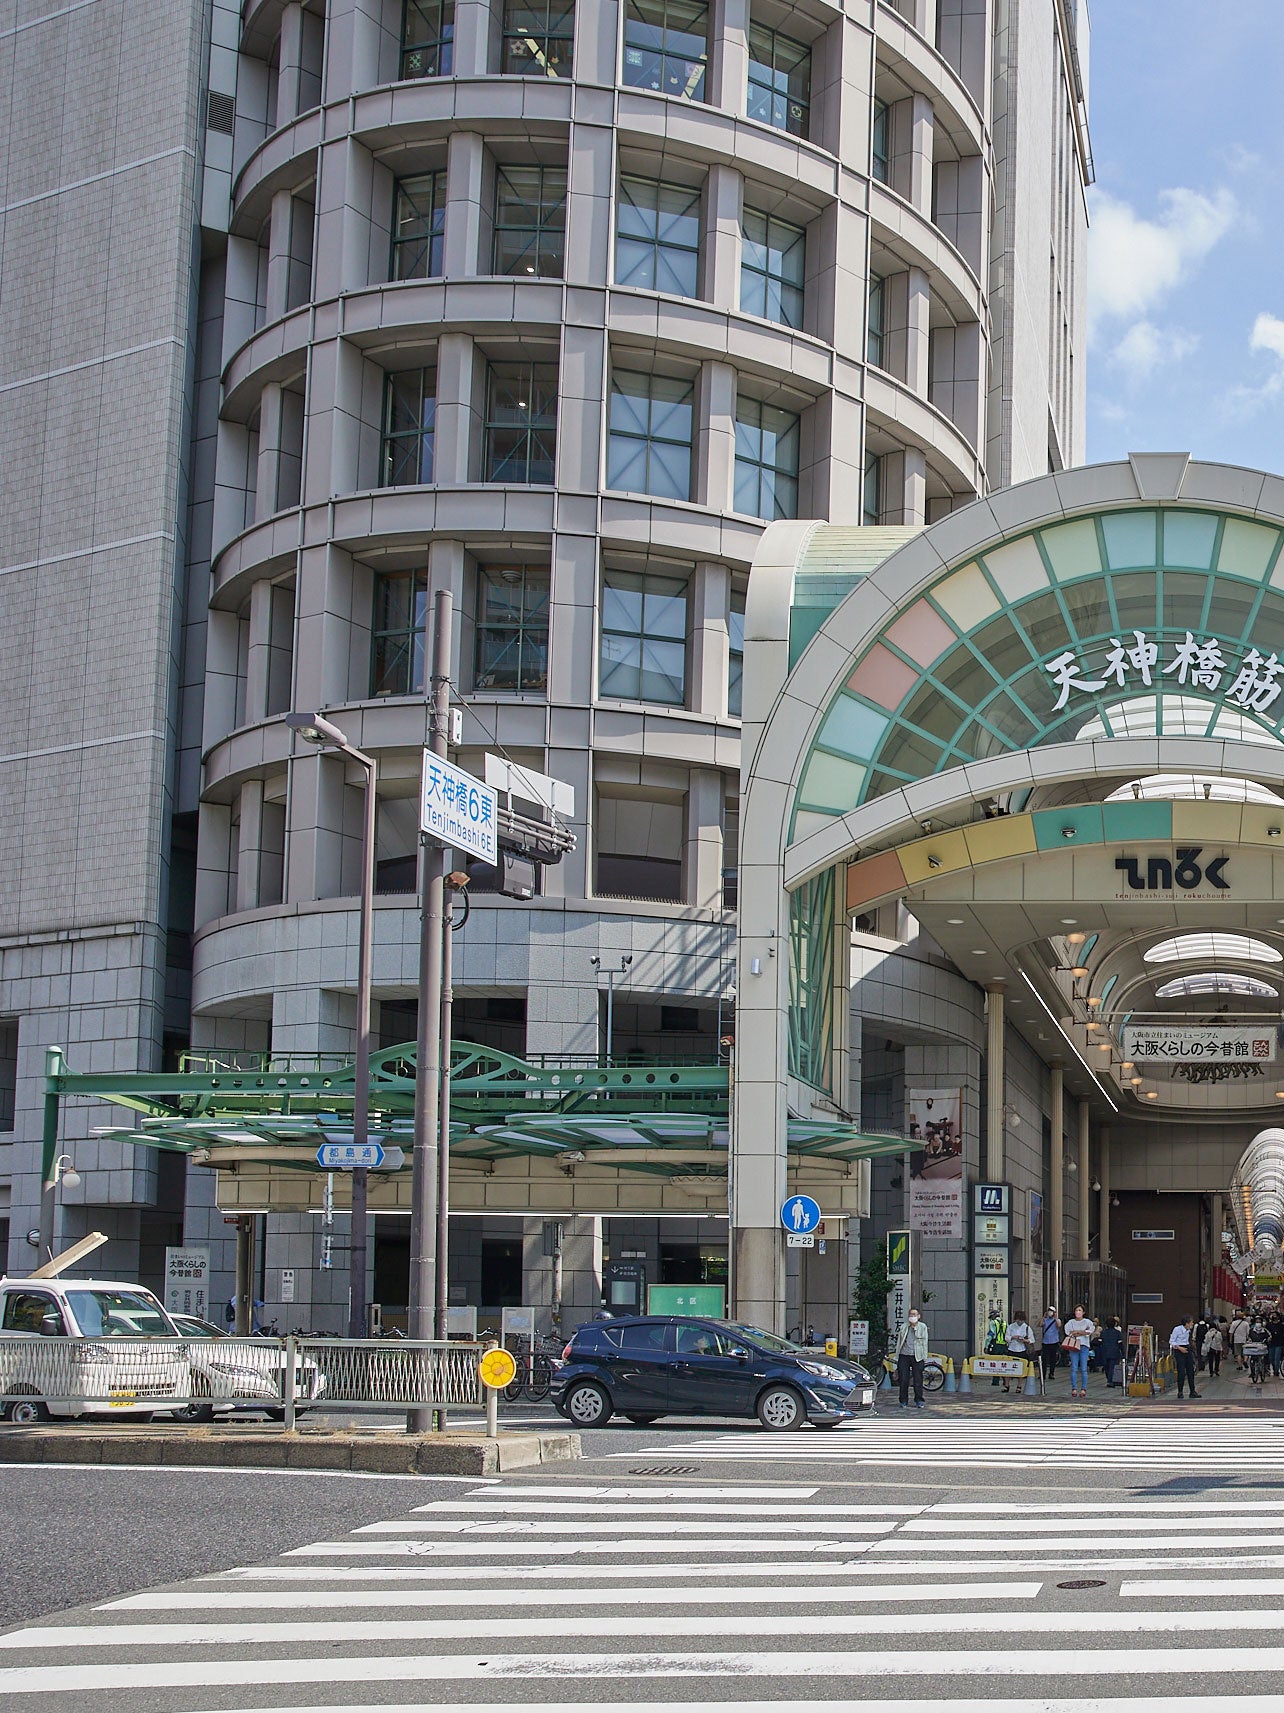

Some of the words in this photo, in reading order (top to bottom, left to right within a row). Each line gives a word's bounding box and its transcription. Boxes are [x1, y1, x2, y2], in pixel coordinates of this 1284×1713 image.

[427, 764, 493, 830] 天神橋6東
[427, 803, 480, 848] Tenjimbashi
[481, 834, 494, 854] 6E.
[1131, 1031, 1219, 1039] 大阪市立住まいのミュージアム
[1130, 1040, 1249, 1056] 大阪くらしの今昔館
[329, 1147, 372, 1157] 都島通
[789, 1236, 812, 1245] 7-22
[169, 1260, 207, 1268] 大阪くらしの
[169, 1269, 192, 1278] 今昔館
[894, 1278, 904, 1332] 三井住友
